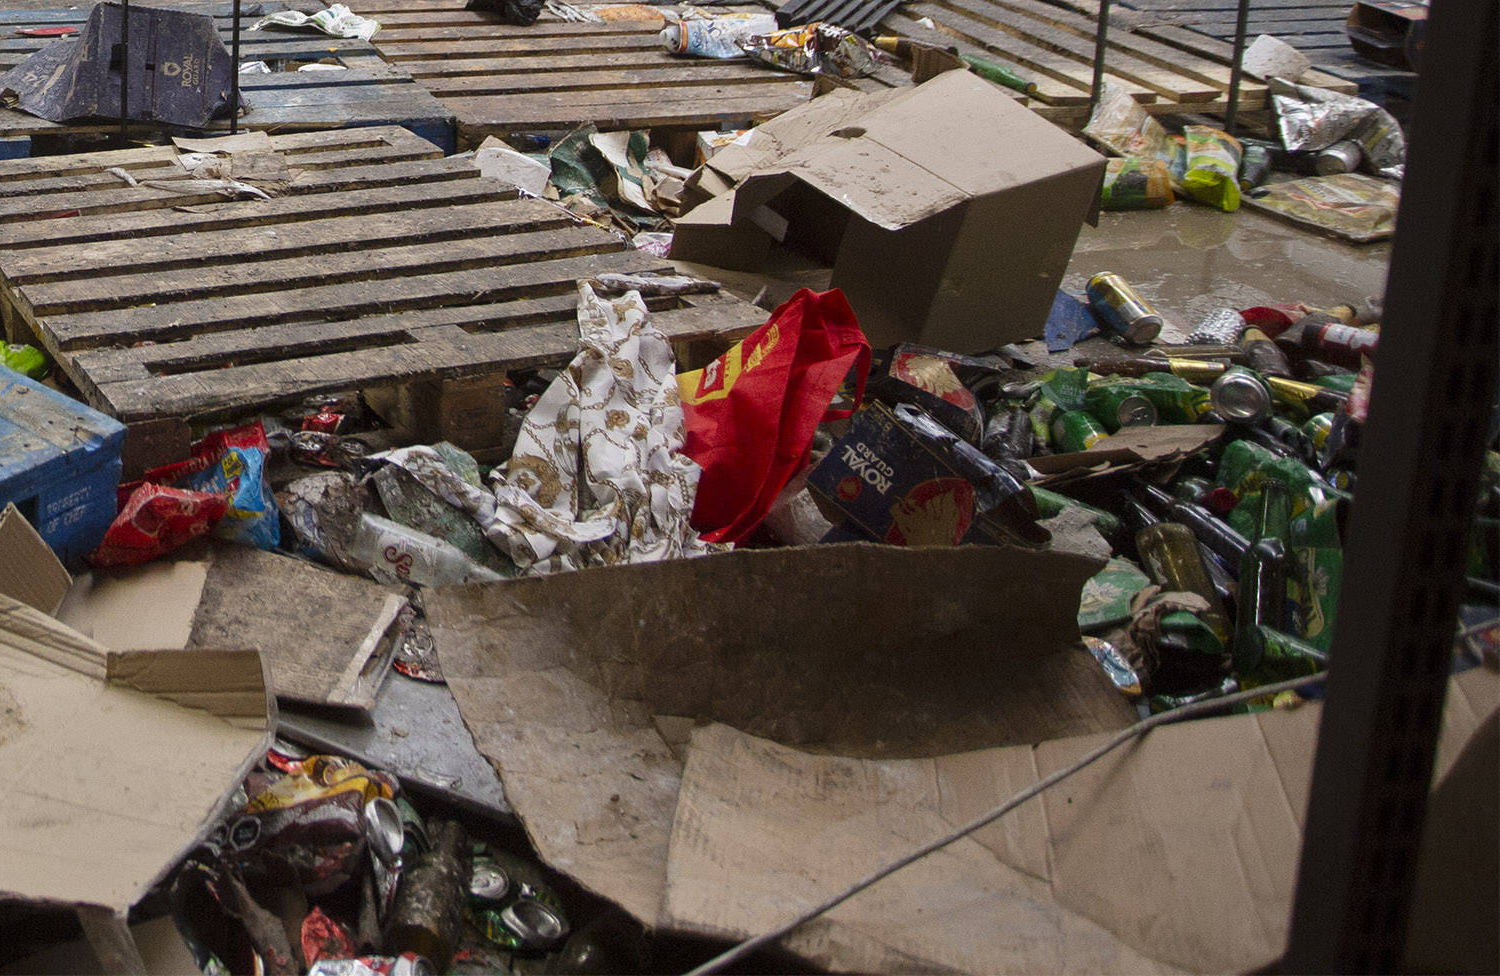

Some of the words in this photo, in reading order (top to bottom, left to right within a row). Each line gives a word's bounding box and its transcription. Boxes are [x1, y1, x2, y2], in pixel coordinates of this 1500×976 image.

[181, 53, 193, 88] ROYAL
[192, 58, 200, 86] GUARD
[840, 444, 893, 496] ROYAL
[856, 441, 895, 478] GUARD
